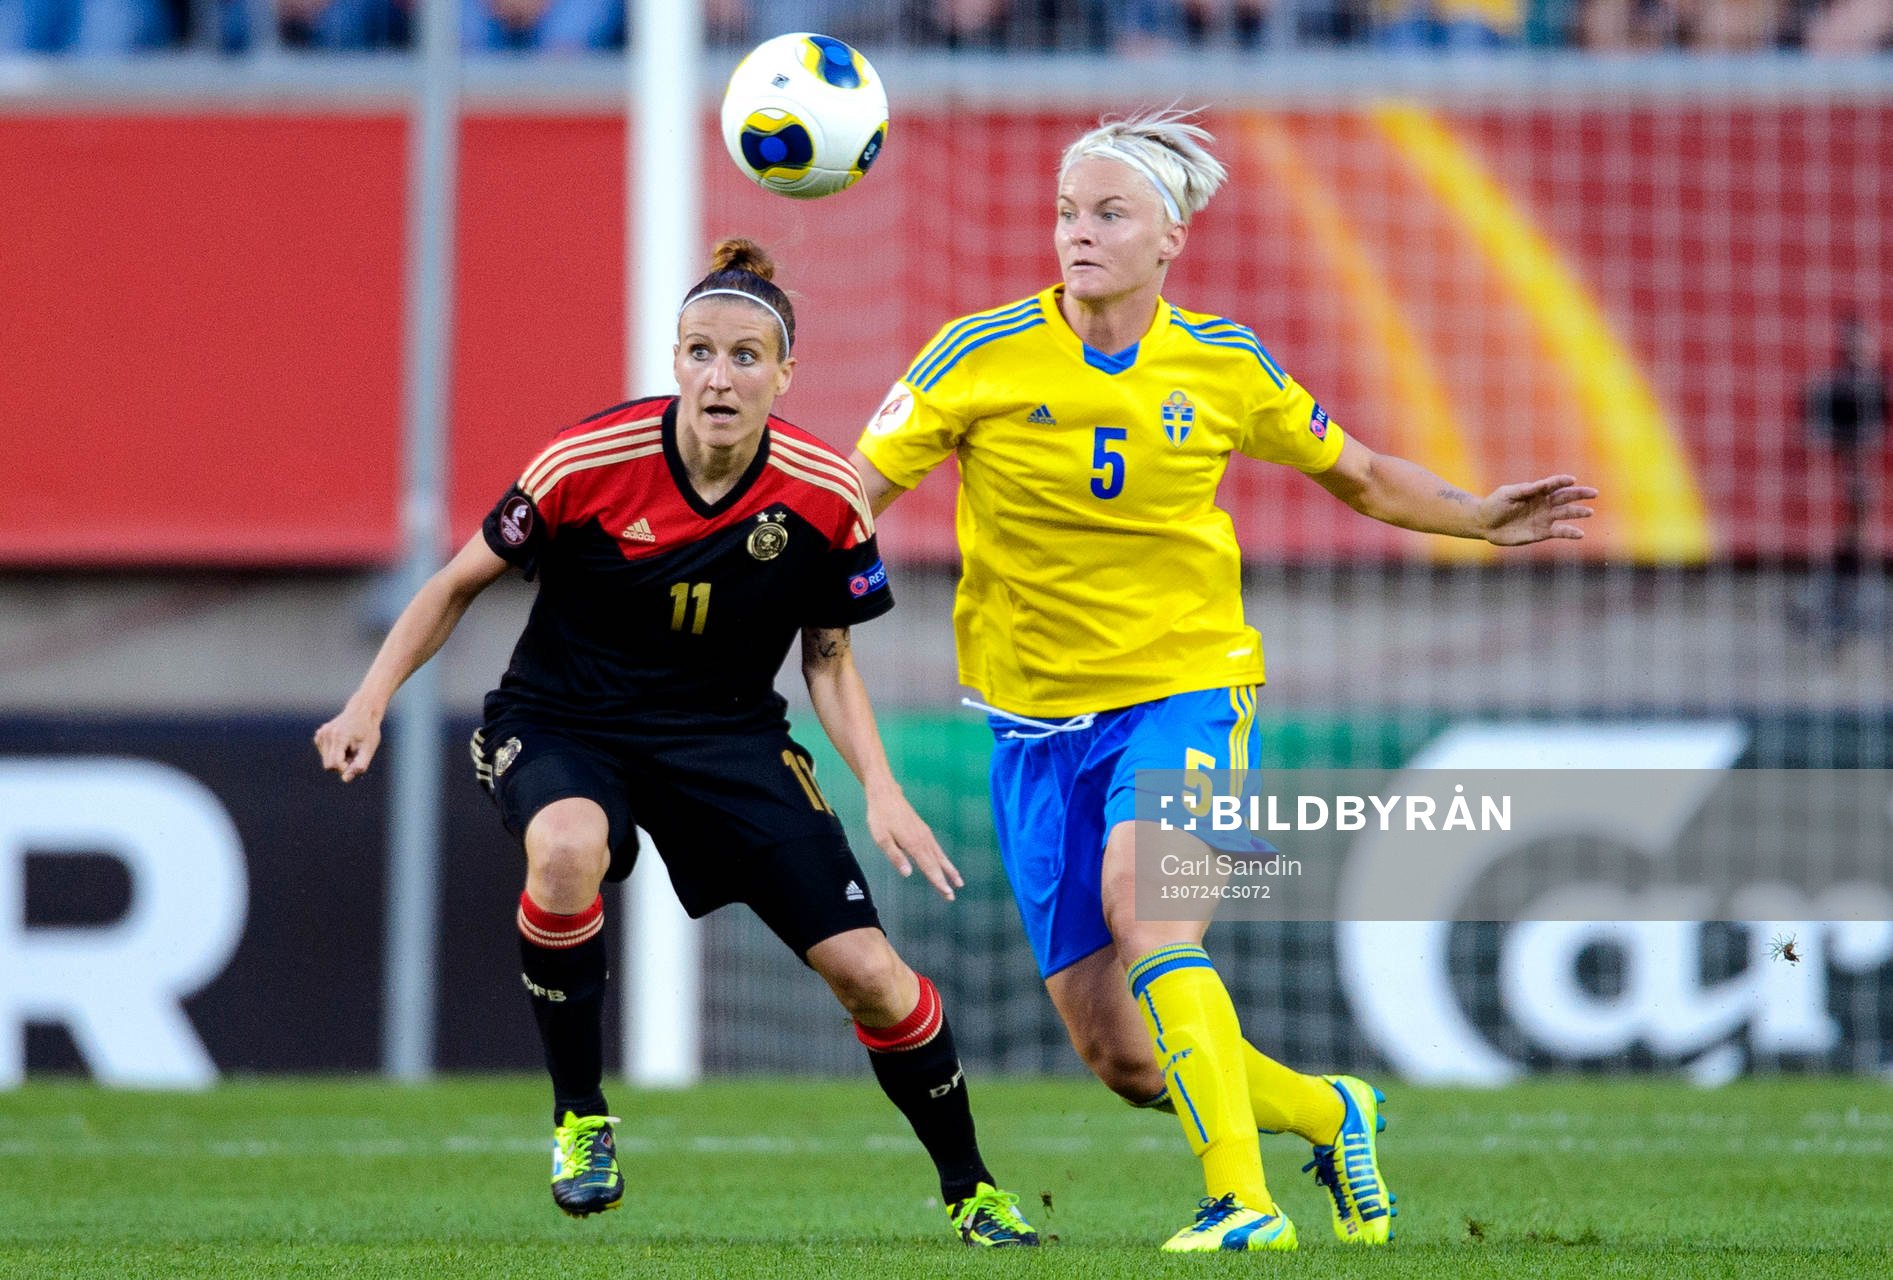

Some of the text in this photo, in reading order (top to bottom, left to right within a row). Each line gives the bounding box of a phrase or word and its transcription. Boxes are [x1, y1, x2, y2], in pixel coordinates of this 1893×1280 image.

[1089, 426, 1128, 500] 5
[622, 530, 656, 543] adidas
[670, 582, 712, 635] 11
[868, 564, 886, 586] RES
[782, 749, 836, 817] 11
[1182, 747, 1217, 818] 5
[0, 756, 250, 1090] R
[1336, 720, 1893, 1090] Car
[929, 1057, 965, 1099] DF
